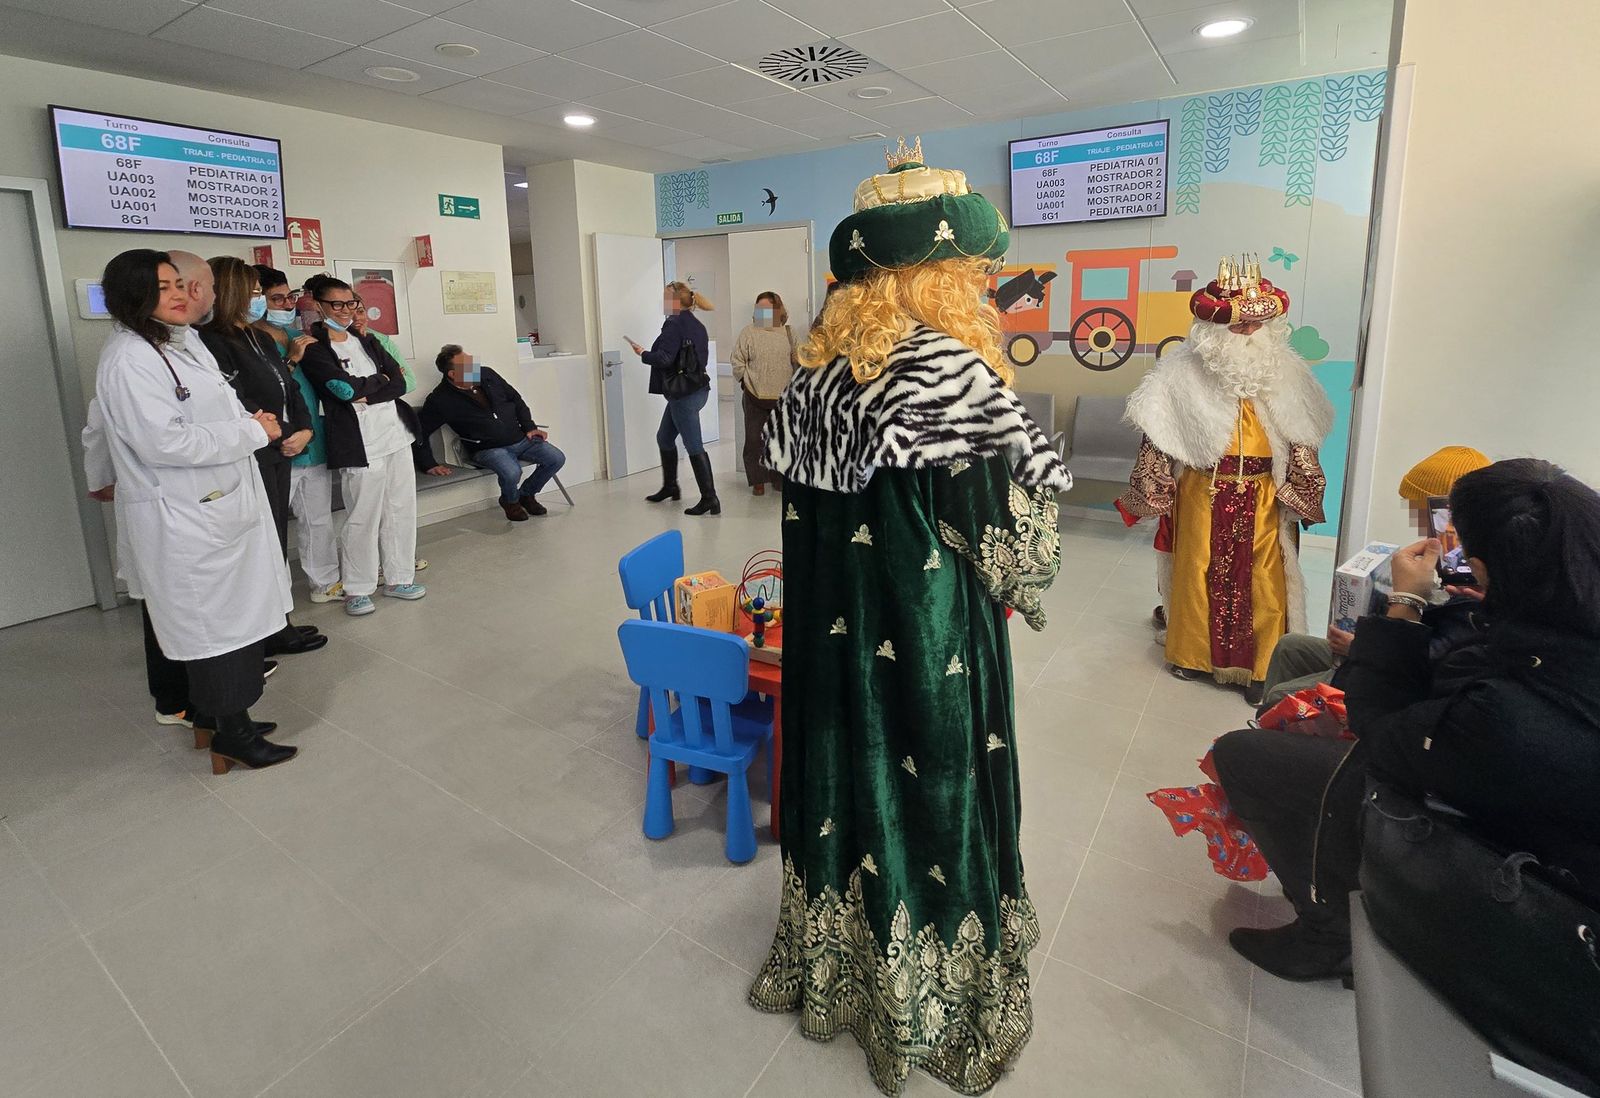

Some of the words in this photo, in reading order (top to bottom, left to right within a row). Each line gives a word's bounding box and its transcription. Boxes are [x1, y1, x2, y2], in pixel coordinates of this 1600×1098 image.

[104, 119, 138, 131] Turno
[1107, 128, 1141, 138] Consulta
[101, 133, 141, 151] 68F
[208, 135, 250, 147] Consulta
[1087, 147, 1110, 155] TRIAJE
[1116, 142, 1153, 151] PEDIATRIA
[183, 147, 214, 158] TRIAJE
[221, 152, 265, 164] PEDIATRIA
[1035, 150, 1059, 164] 68F
[116, 158, 141, 169] 68F
[1090, 159, 1145, 172] PEDIATRIA
[1148, 157, 1159, 165] 01
[107, 171, 154, 184] UA003
[189, 166, 257, 182] PEDIATRIA
[261, 175, 273, 184] 01
[1042, 168, 1058, 177] 68F
[1087, 170, 1154, 183] MOSTRADOR
[187, 179, 268, 196] MOSTRADOR
[271, 187, 277, 196] 2
[1037, 179, 1065, 188] UA003
[1087, 182, 1154, 195] MOSTRADOR
[1156, 180, 1161, 188] 2
[109, 185, 156, 199] UA002
[1037, 190, 1065, 199] UA002
[111, 199, 156, 212] UA001
[188, 193, 269, 208] MOSTRADOR
[272, 200, 278, 209] 2
[1037, 201, 1064, 210] UA001
[1087, 194, 1153, 206] MOSTRADOR
[190, 206, 270, 220] MOSTRADOR
[273, 212, 279, 221] 2
[1090, 206, 1144, 216] PEDIATRIA
[1147, 204, 1158, 212] 01
[122, 214, 150, 225] 8G1
[719, 214, 741, 223] SALIDA
[194, 219, 261, 232] PEDIATRIA
[264, 224, 276, 233] 01
